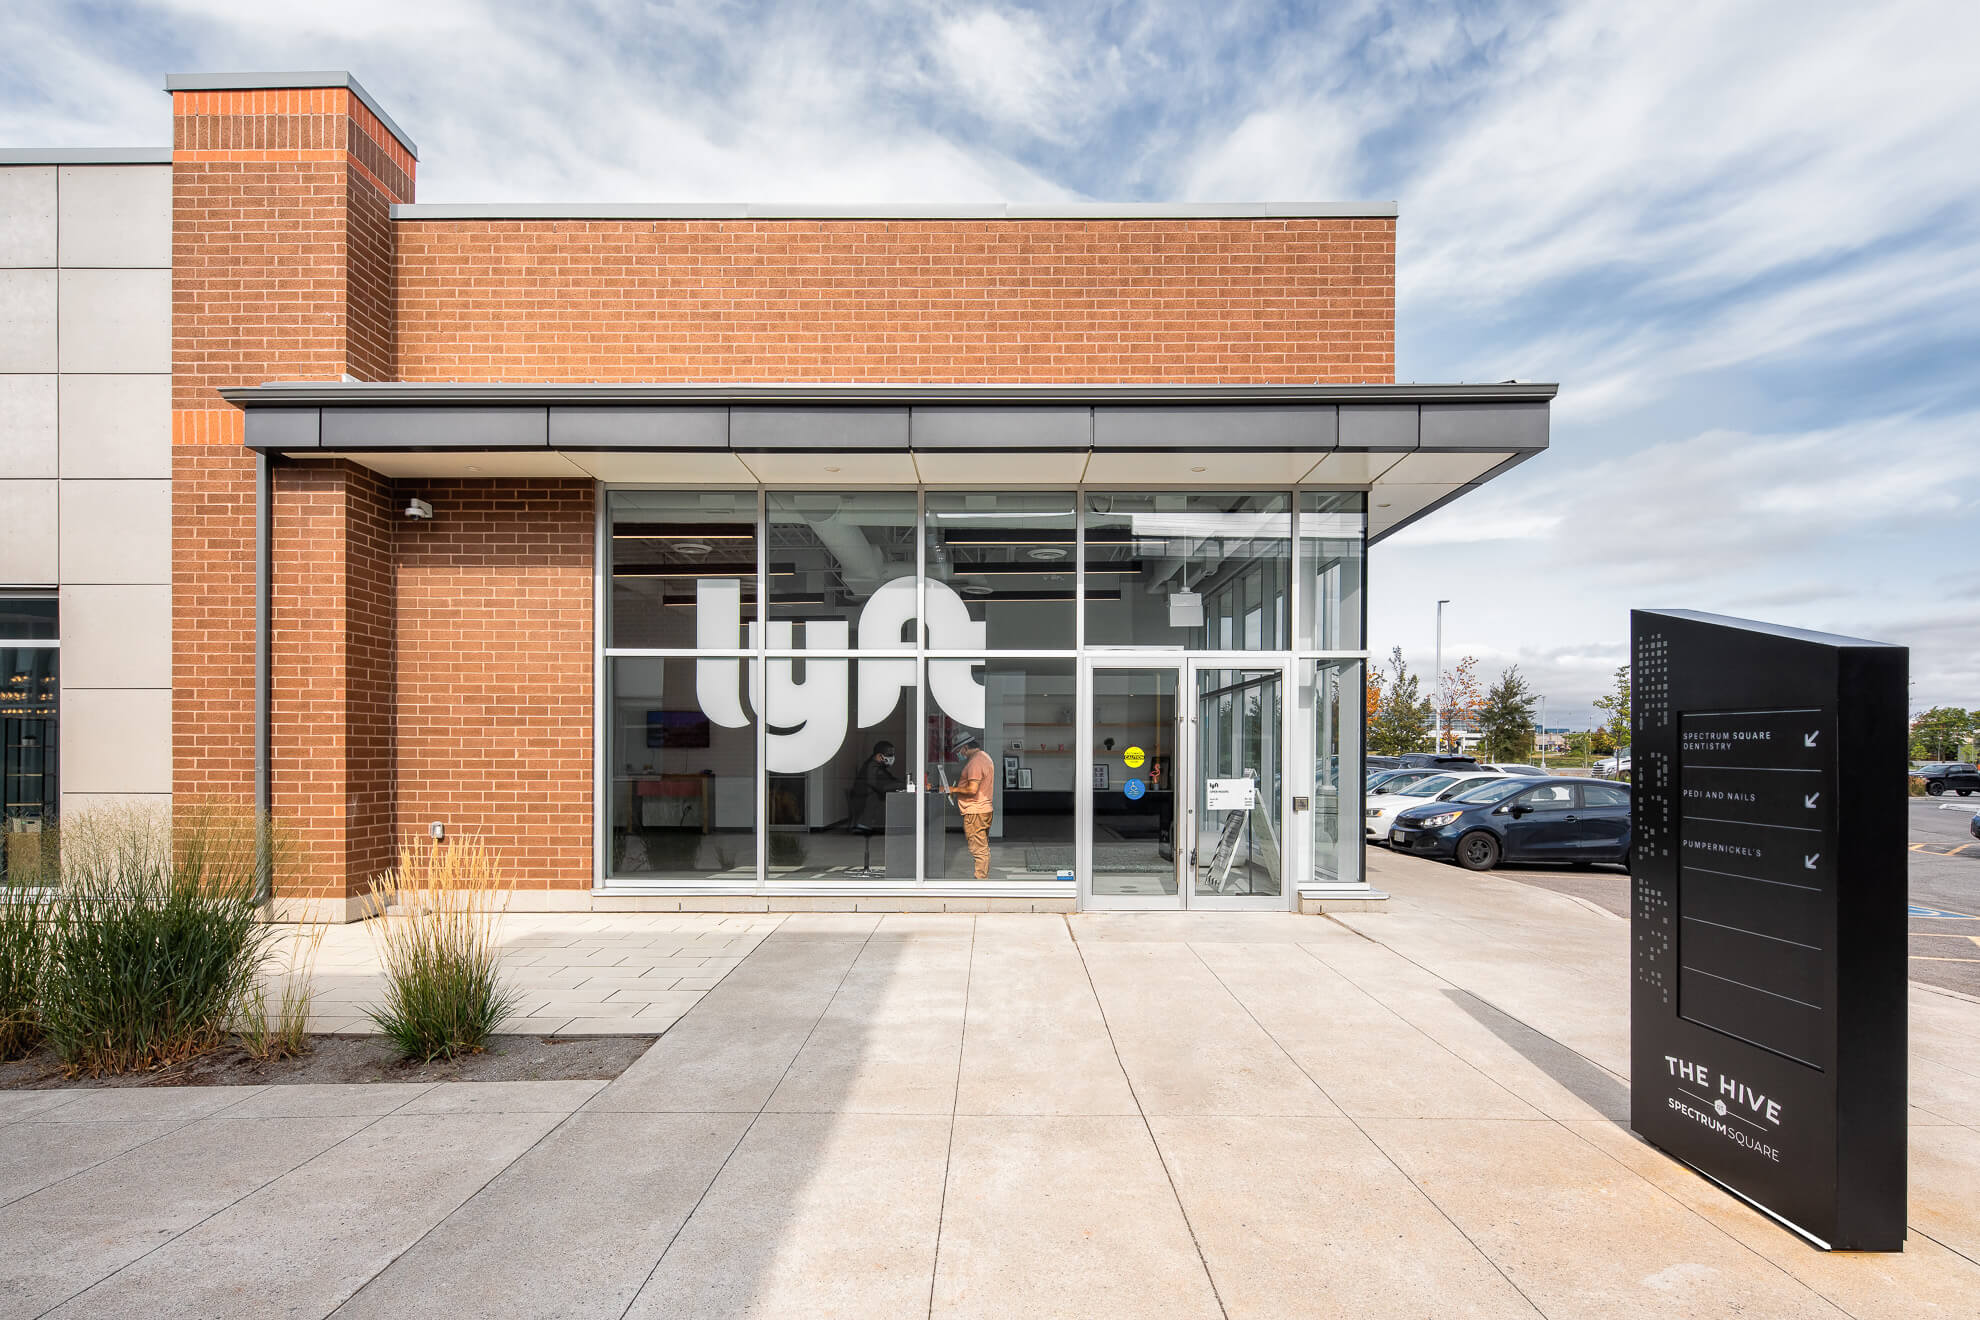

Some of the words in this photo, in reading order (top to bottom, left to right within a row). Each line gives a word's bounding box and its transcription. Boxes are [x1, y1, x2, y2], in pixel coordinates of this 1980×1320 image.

[696, 575, 986, 773] lyft
[1683, 732, 1729, 740] SPECTRUM
[1732, 731, 1771, 740] SQUARE
[1683, 742, 1732, 750] DENTISTRY
[1683, 789, 1703, 798] PEDI
[1705, 791, 1724, 800] AND
[1727, 792, 1756, 802] NAILS
[1683, 839, 1761, 857] PUMPERNICKEL'S
[1664, 1055, 1709, 1088] THE
[1720, 1074, 1782, 1126] HIVE
